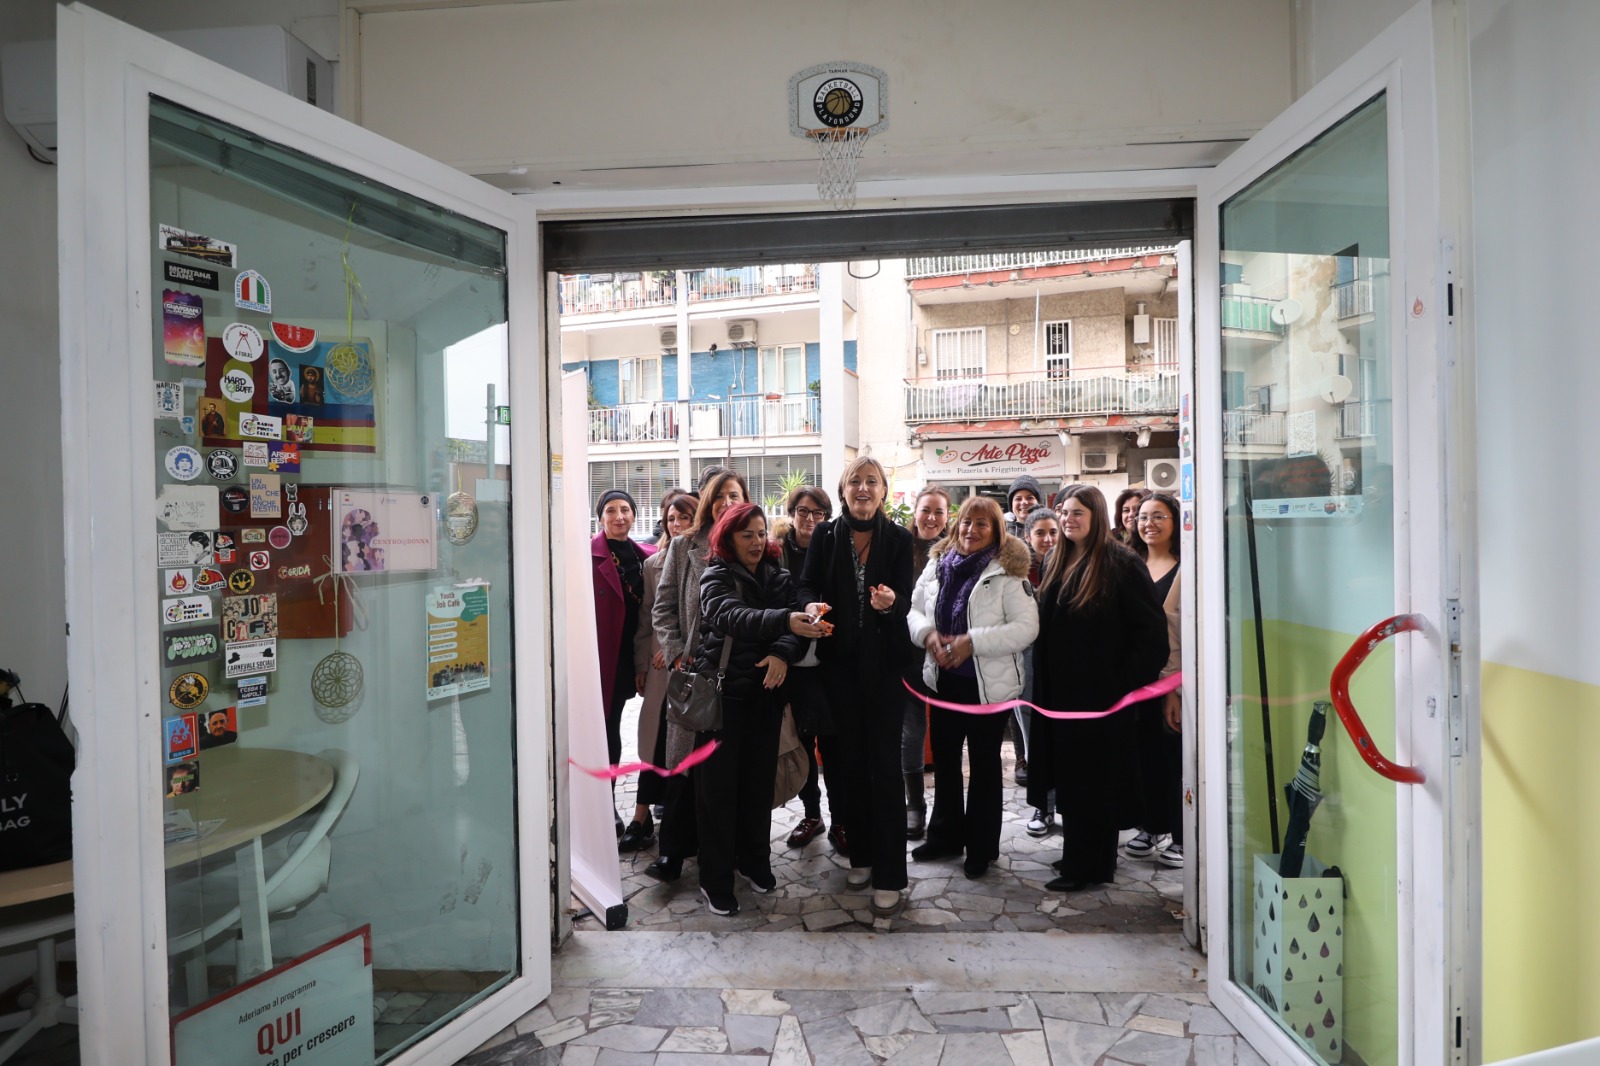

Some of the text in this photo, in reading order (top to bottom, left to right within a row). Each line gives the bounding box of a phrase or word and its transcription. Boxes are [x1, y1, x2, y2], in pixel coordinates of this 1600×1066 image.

[818, 81, 859, 101] BASKETBALL
[817, 102, 860, 125] PLAYGROUND
[168, 265, 211, 280] MONTANA
[169, 271, 194, 281] CANS
[156, 382, 180, 392] NARUTO
[224, 375, 247, 386] HARD
[960, 442, 1052, 465] Arte Pizza
[991, 466, 1027, 474] Friggitoria
[287, 564, 311, 576] GRIDA
[439, 592, 455, 600] Youth
[436, 601, 446, 609] Job
[227, 662, 255, 672] CARNEVALE
[257, 659, 275, 668] SOCIALE
[0, 816, 31, 831] AG
[238, 979, 317, 1025] Aderiamo al programma
[257, 1007, 302, 1055] QUI
[283, 1044, 304, 1066] per
[306, 1014, 356, 1051] crescere
